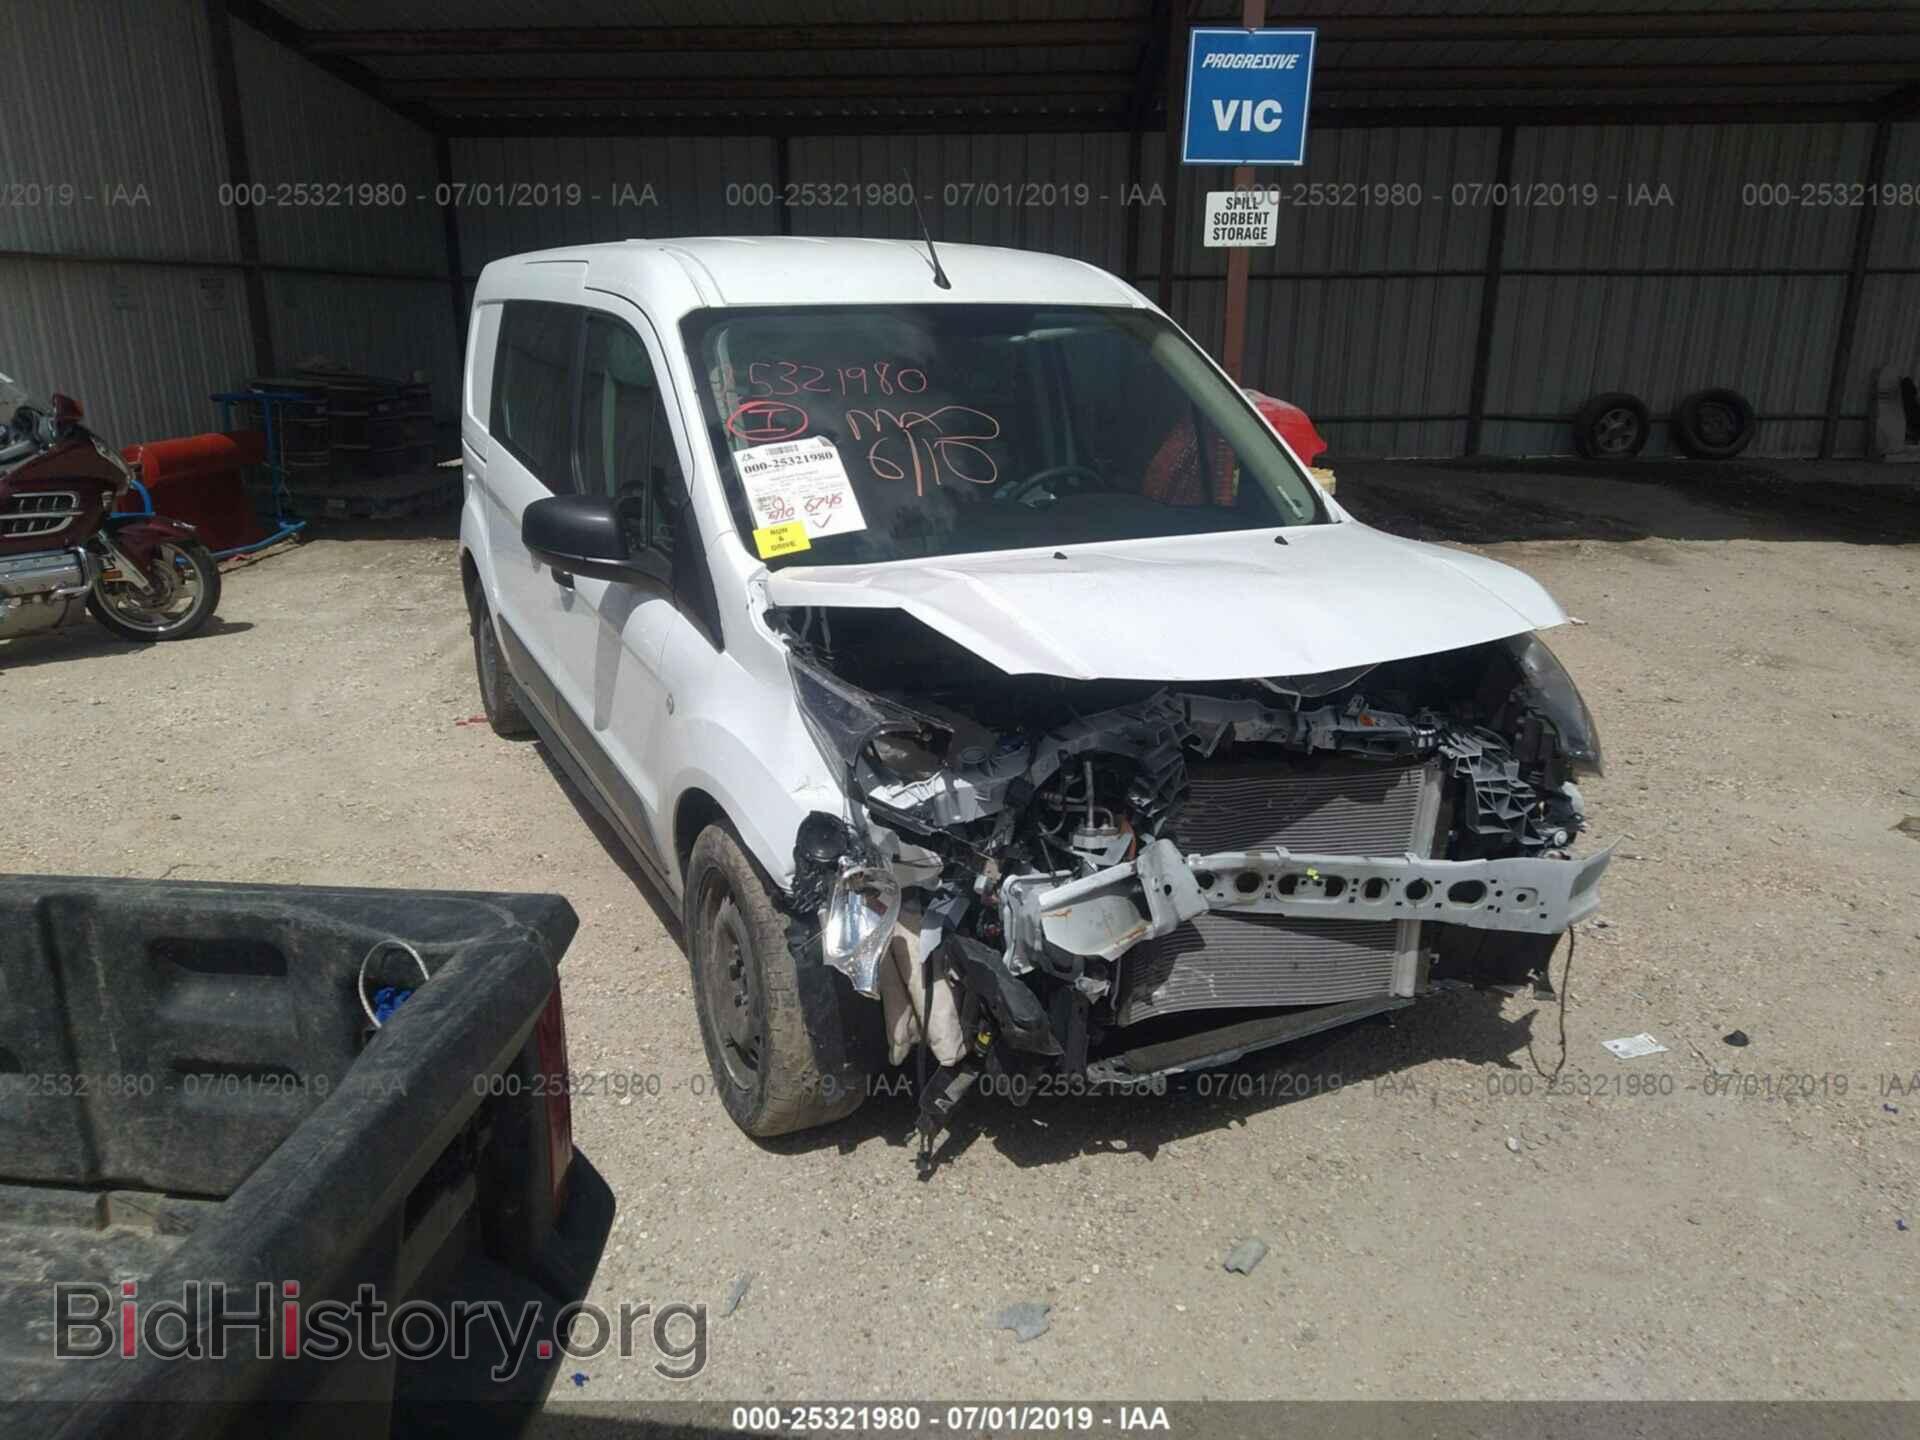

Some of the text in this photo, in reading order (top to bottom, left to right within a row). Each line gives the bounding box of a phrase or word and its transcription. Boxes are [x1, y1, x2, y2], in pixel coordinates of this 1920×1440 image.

[1202, 53, 1299, 69] PROGRESSIVE
[1212, 99, 1282, 132] VIC
[1225, 197, 1258, 210] SPILL
[1214, 212, 1269, 225] SORBENT
[1213, 227, 1267, 240] STORAGE
[744, 451, 833, 474] 000-25321980
